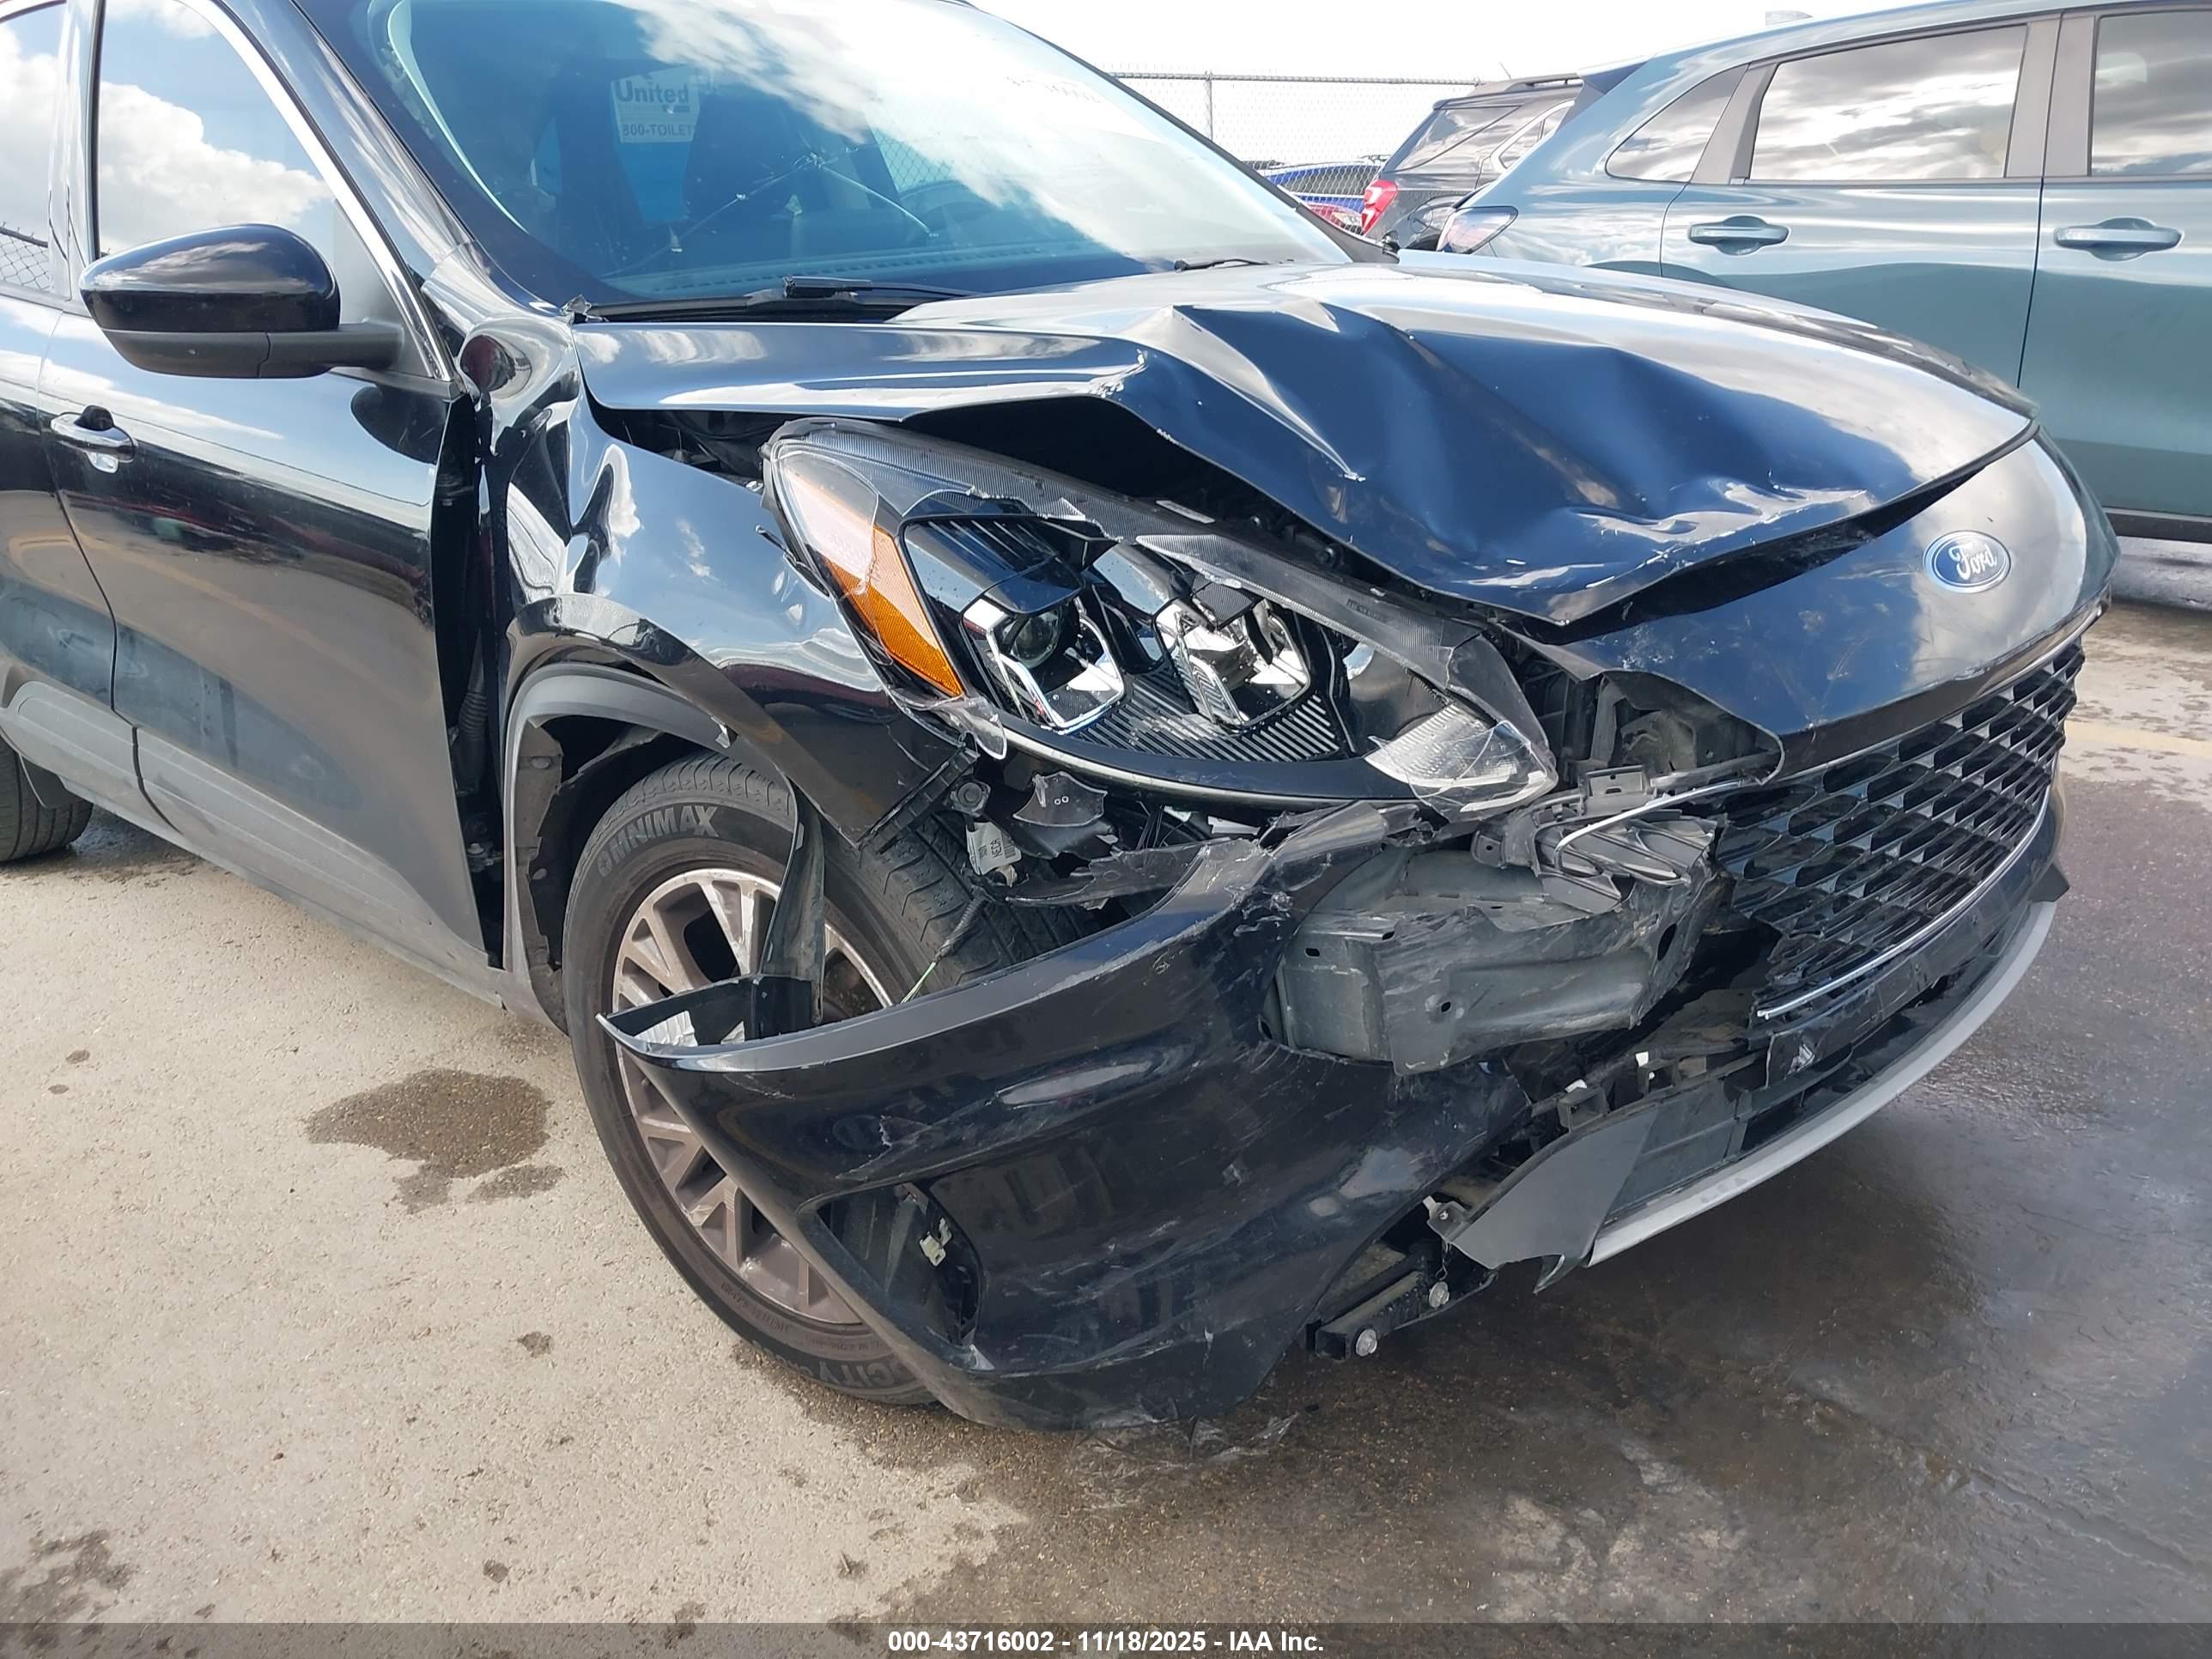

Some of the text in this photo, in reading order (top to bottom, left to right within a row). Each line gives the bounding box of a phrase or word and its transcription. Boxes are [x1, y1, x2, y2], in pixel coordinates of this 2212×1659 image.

[614, 79, 690, 104] United
[1947, 541, 1998, 580] Ford
[597, 805, 720, 878] OMNIMAX
